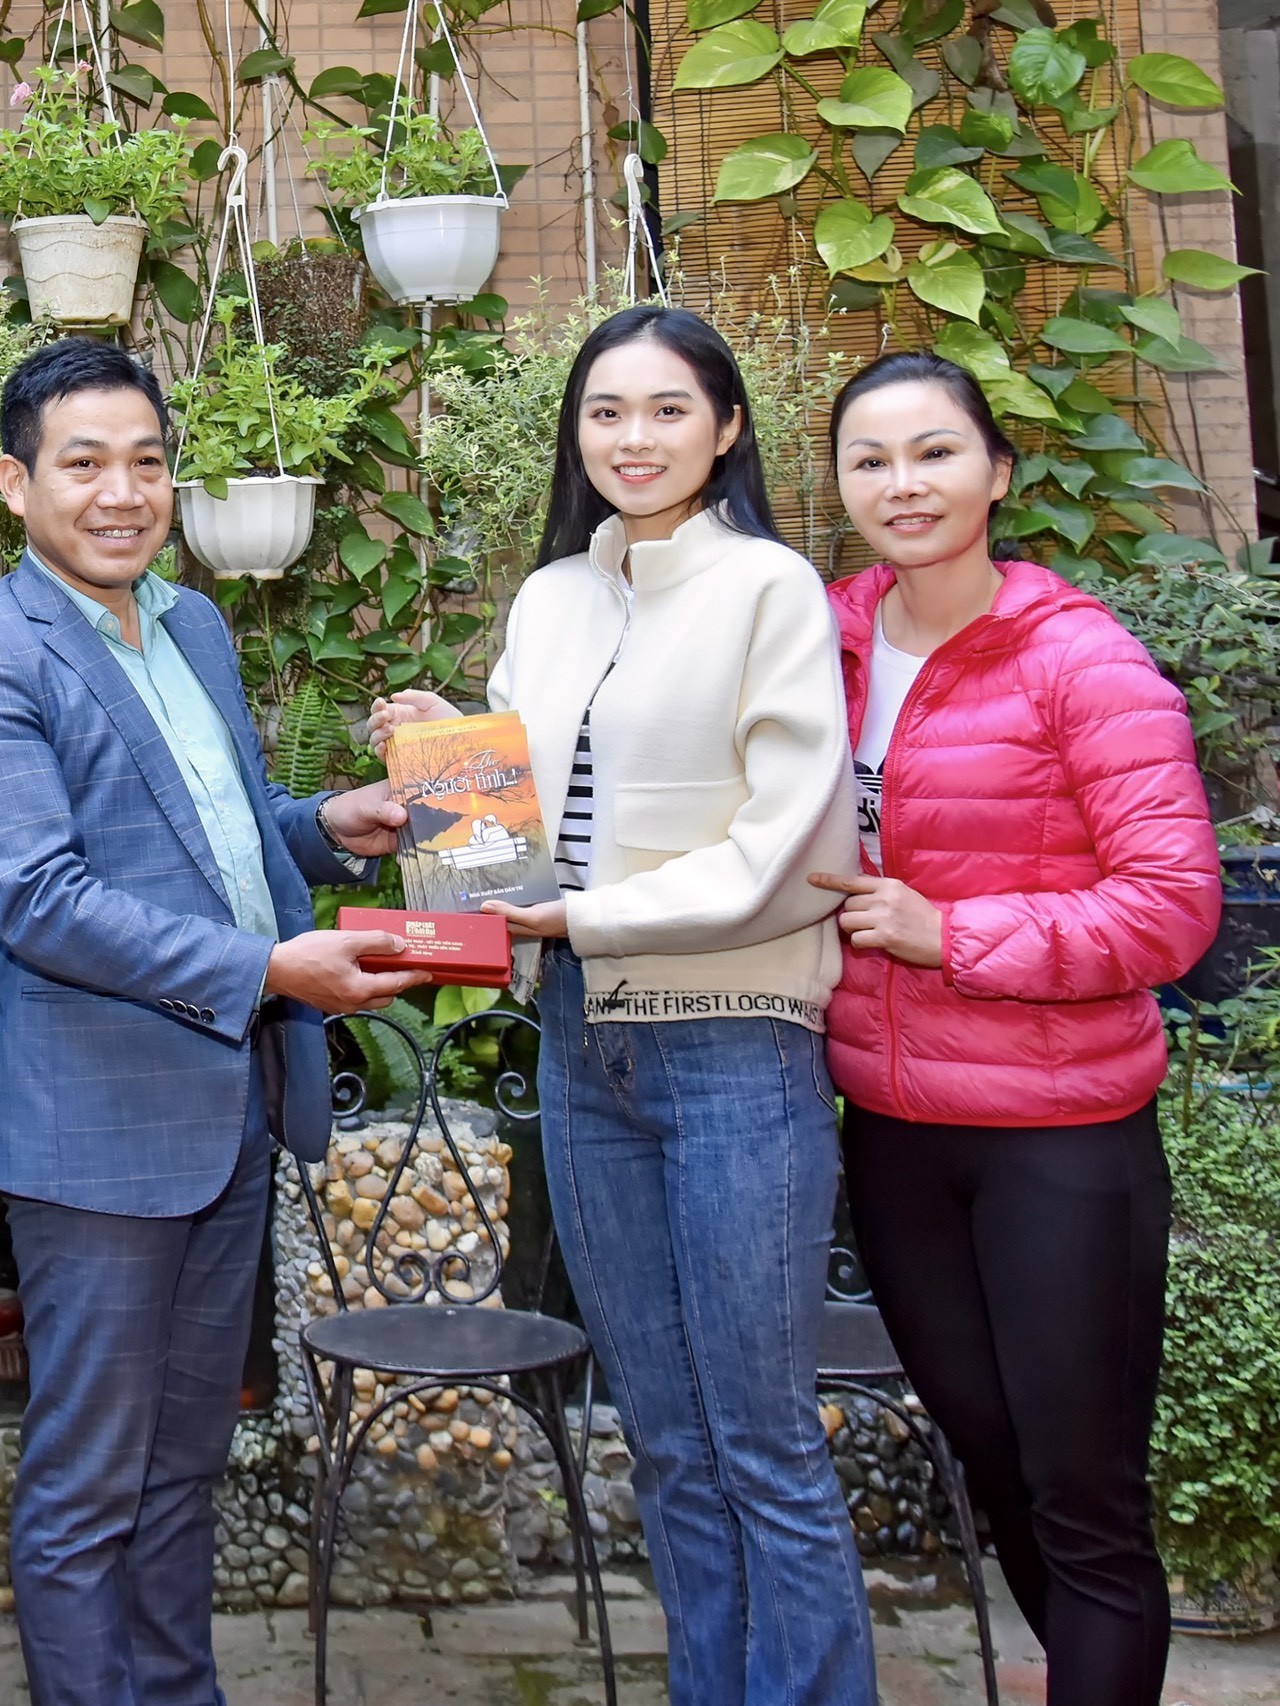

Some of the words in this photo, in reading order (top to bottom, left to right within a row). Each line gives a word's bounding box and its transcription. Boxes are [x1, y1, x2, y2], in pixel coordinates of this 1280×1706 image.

[623, 998, 659, 1015] THE
[663, 994, 722, 1014] FIRST
[725, 994, 785, 1012] LOGO
